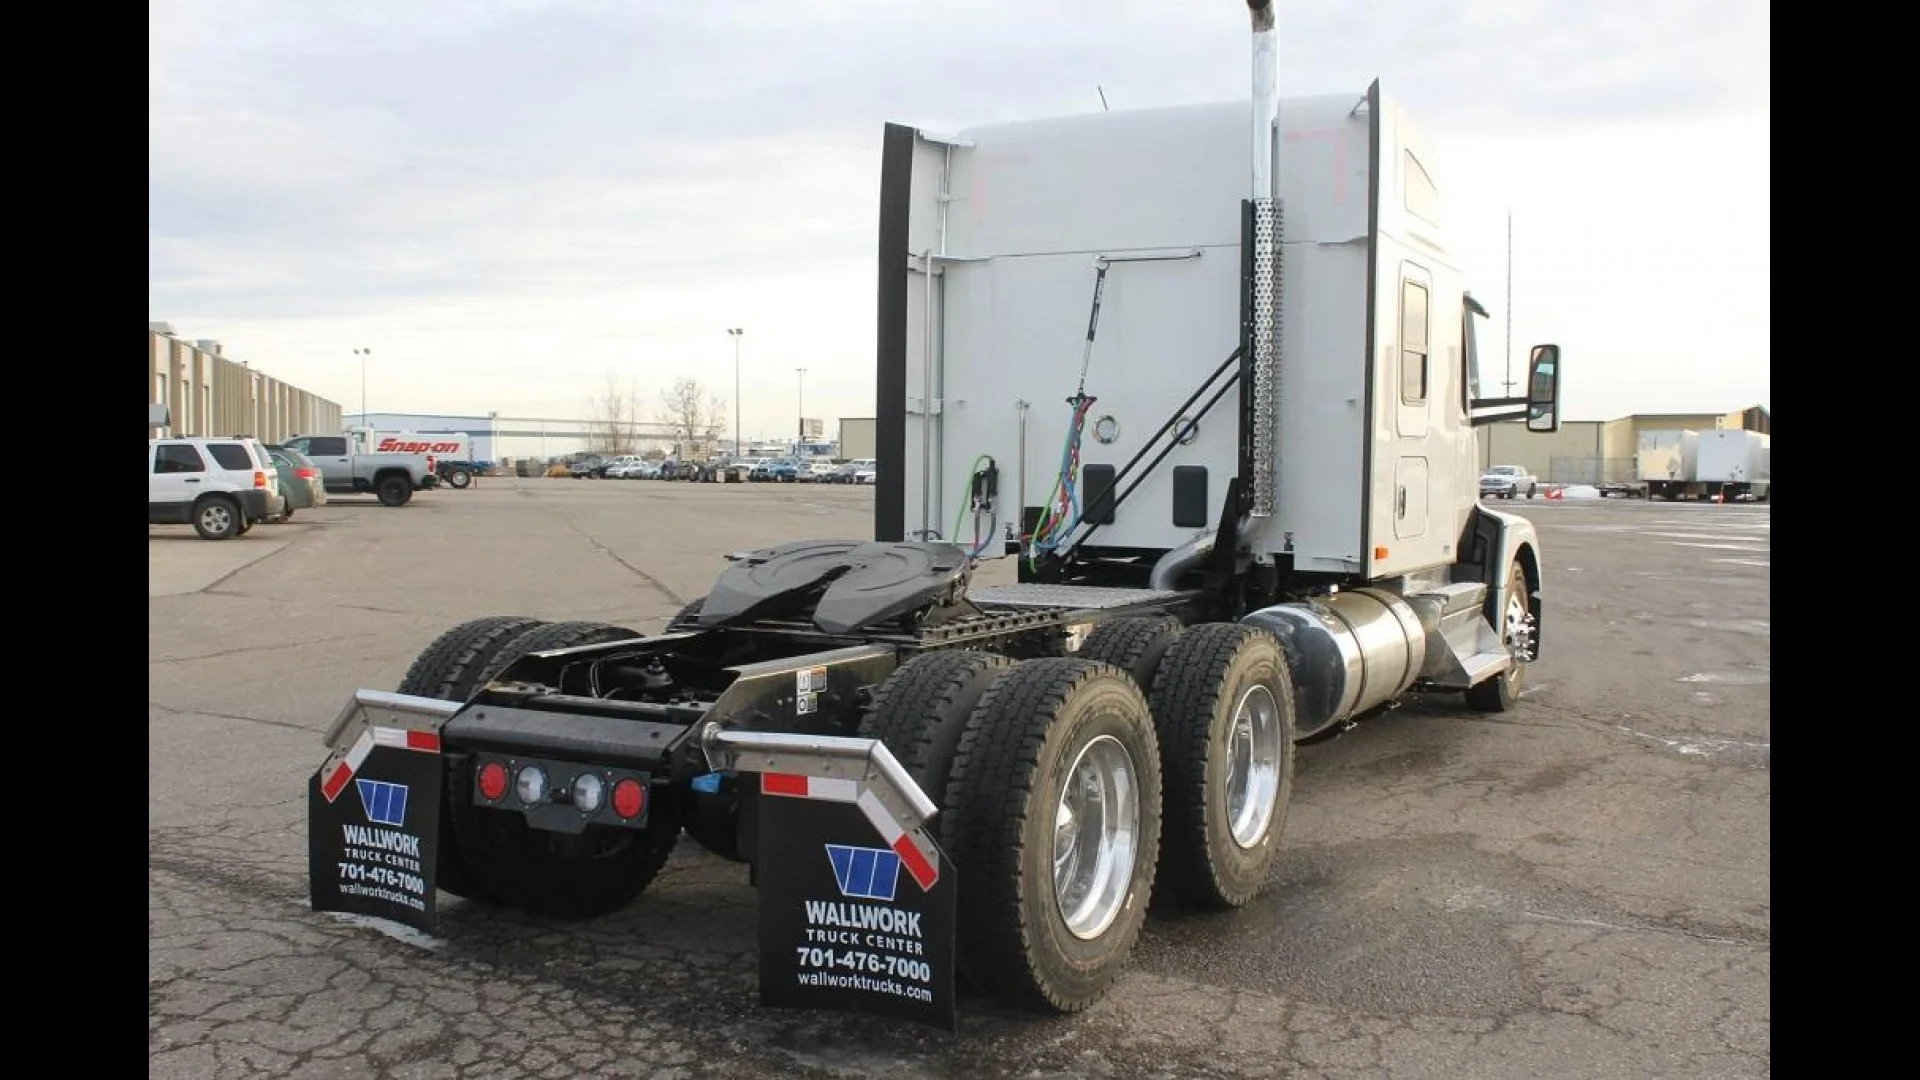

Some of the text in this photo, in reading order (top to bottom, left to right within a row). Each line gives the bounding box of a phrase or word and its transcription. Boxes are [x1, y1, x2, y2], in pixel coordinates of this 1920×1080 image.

[376, 438, 460, 455] Snap-on
[342, 824, 420, 858] WALLWORK
[344, 848, 420, 872] TRUCK CENTER
[338, 862, 424, 895] 701-476-7000
[805, 900, 922, 938] WALLWORK
[806, 929, 923, 956] TRUCK CENTER
[797, 947, 931, 983] 701-476-7000
[797, 970, 932, 1003] wallworktrucks.com
